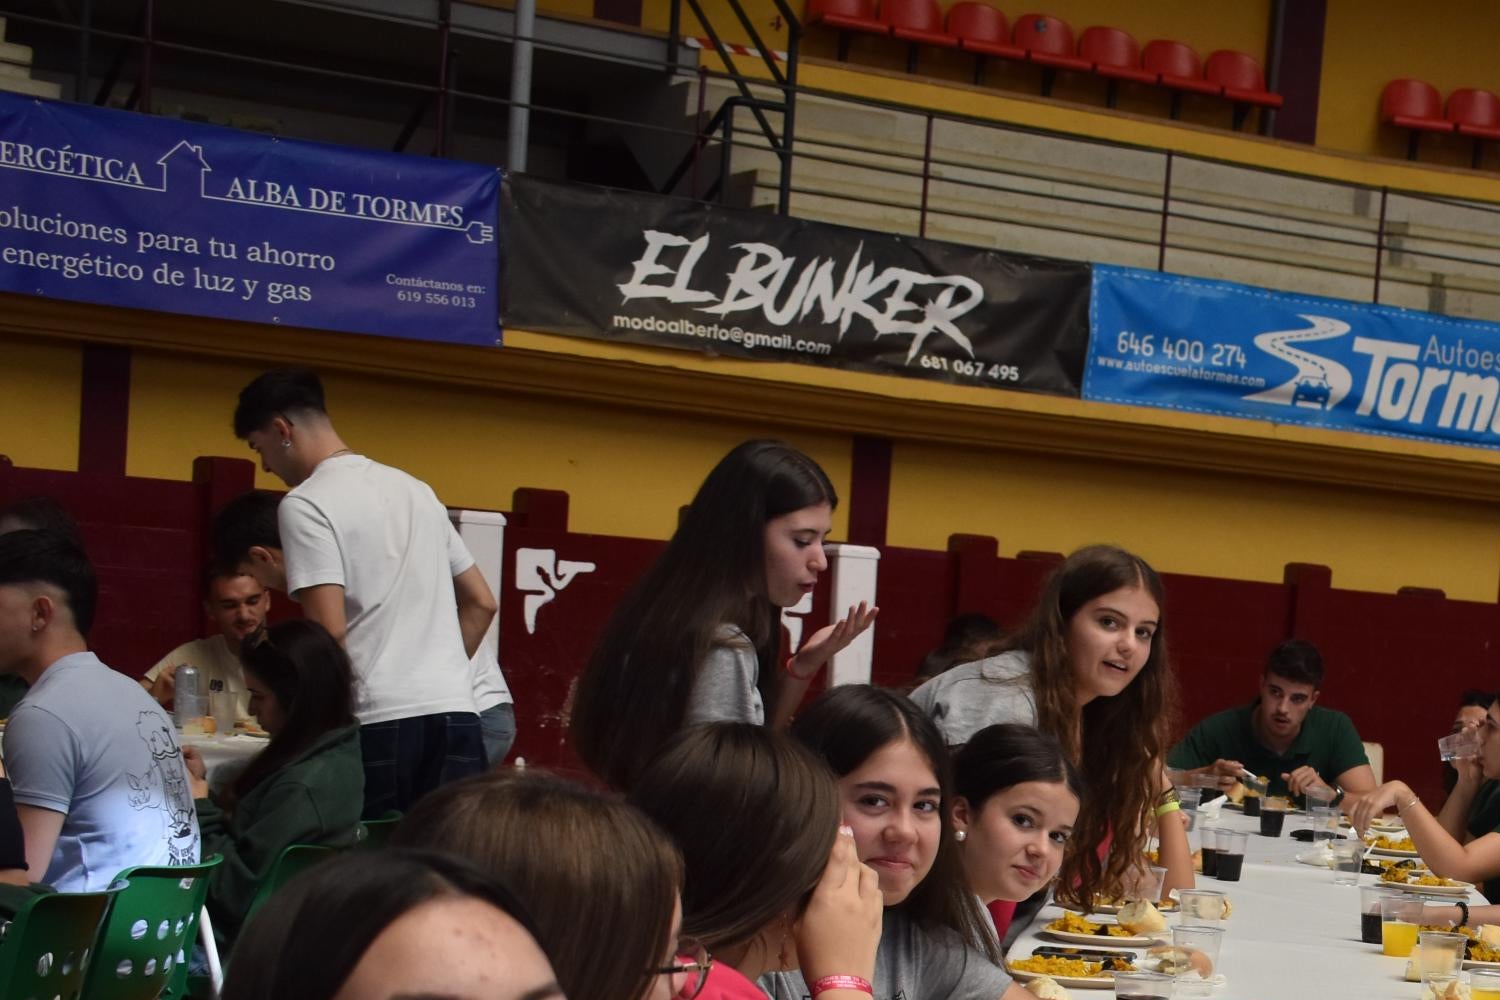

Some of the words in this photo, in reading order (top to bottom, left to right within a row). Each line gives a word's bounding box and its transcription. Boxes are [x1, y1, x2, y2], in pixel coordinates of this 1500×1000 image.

[226, 177, 301, 207] ALBA
[308, 188, 346, 213] DE
[352, 194, 464, 227] TORMES
[137, 231, 200, 254] para
[209, 237, 238, 260] tu
[247, 242, 336, 271] ahorro
[2, 247, 144, 279] energético
[153, 263, 185, 286] de
[194, 267, 235, 293] luz
[242, 279, 259, 301] y
[267, 281, 312, 304] gas
[386, 273, 464, 292] Contáctanos
[397, 290, 422, 303] 619
[425, 293, 449, 306] 556
[452, 296, 476, 308] 013
[616, 229, 724, 305] EL
[692, 239, 985, 366] BUNKER
[613, 313, 832, 356] modoalberto@gmail.com
[1117, 331, 1154, 357] 646
[1162, 337, 1204, 363] 400
[1211, 344, 1247, 368] 274
[920, 355, 949, 371] 681
[953, 359, 984, 377] 067
[987, 364, 1019, 381] 495
[1097, 356, 1265, 387] www.autoescuelatormes.com
